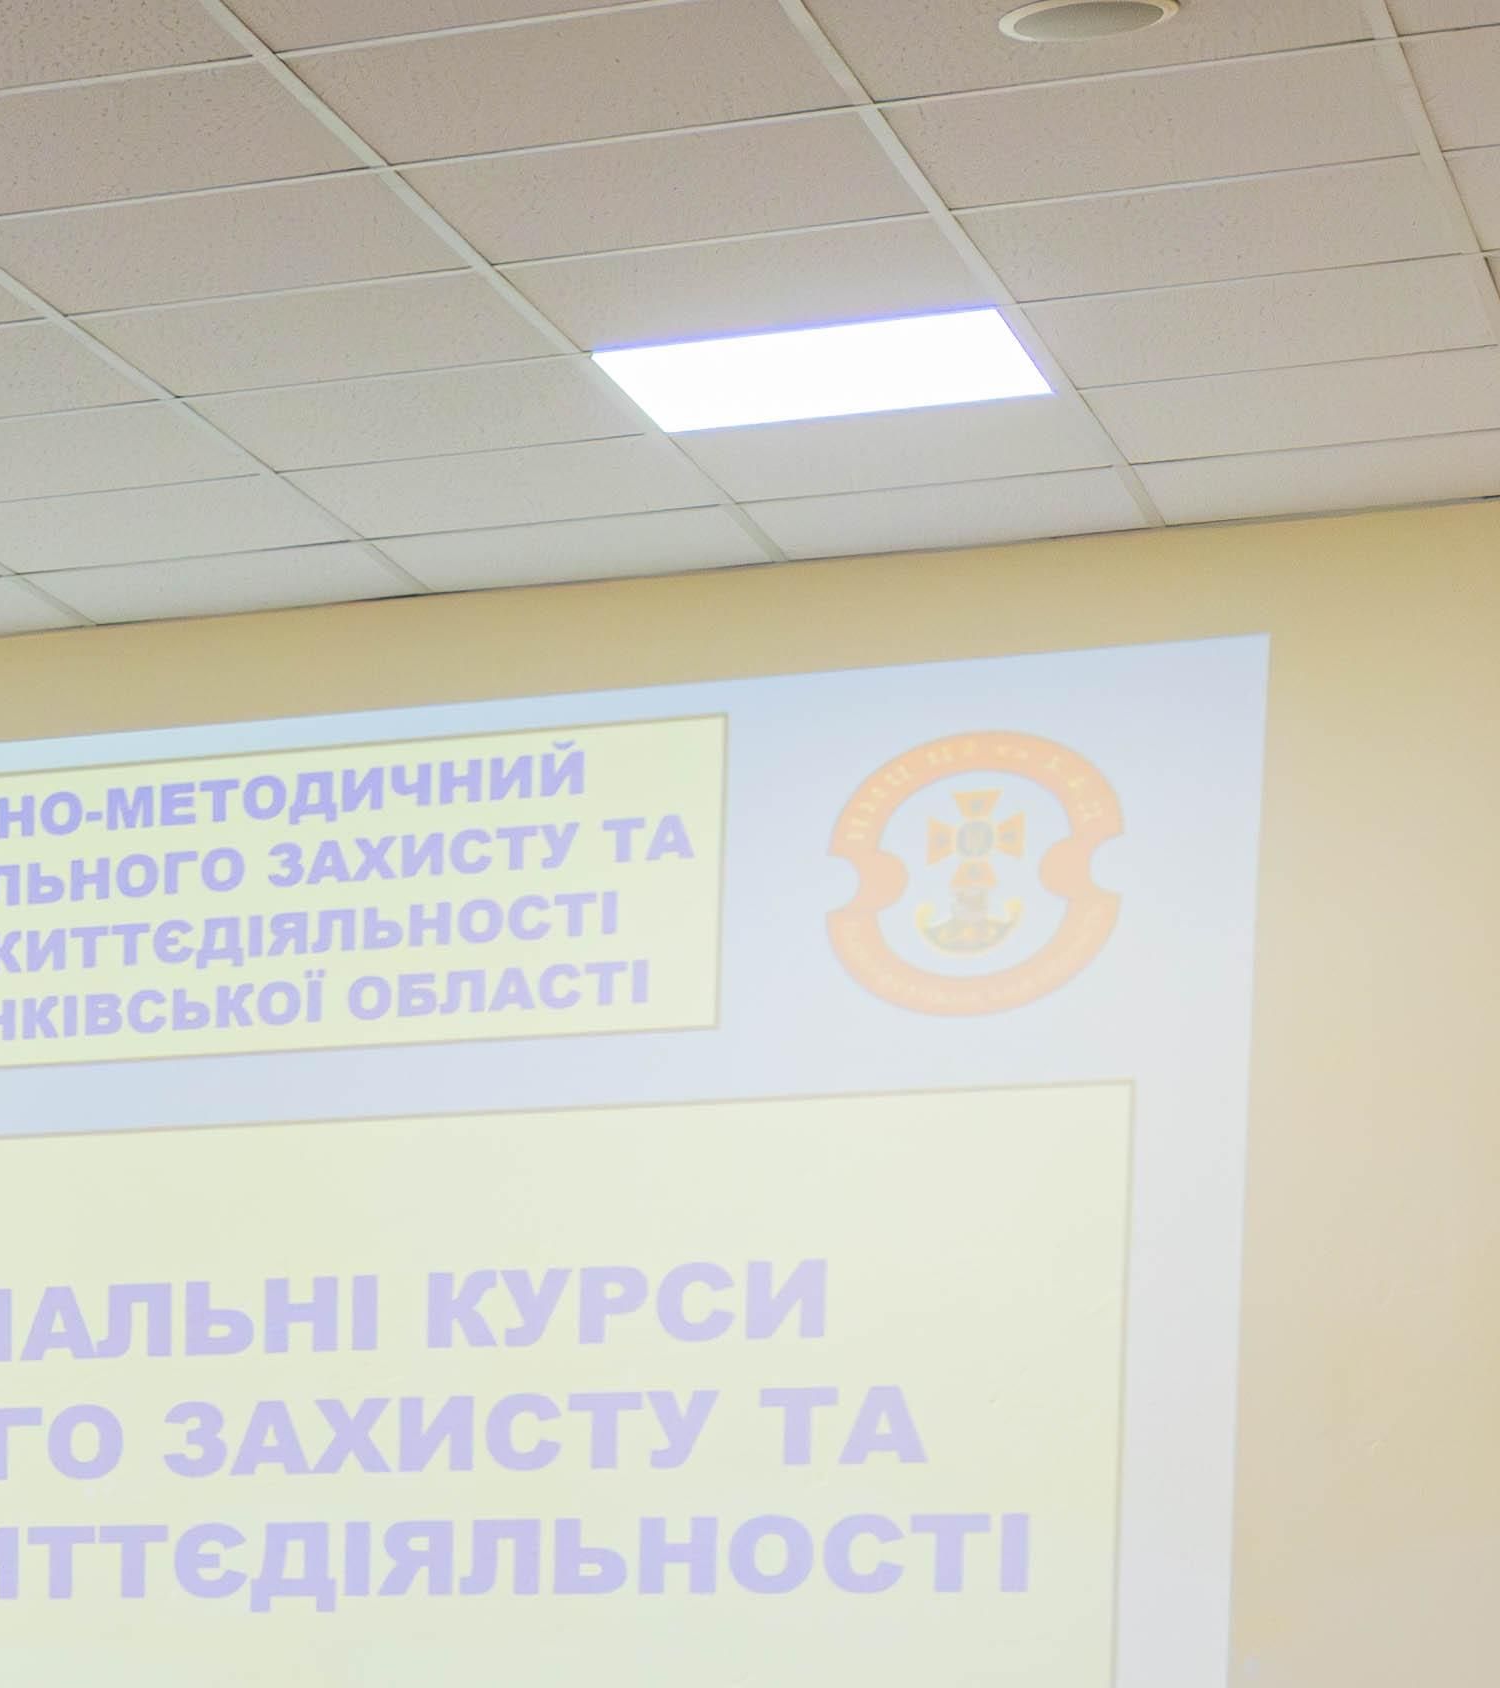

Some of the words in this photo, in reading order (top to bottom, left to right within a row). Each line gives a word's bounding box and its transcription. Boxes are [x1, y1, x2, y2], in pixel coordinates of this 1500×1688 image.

[266, 819, 581, 890] ЗАХИСТУ
[601, 812, 695, 865] ТА
[347, 958, 651, 1022] ОБЛАСТІ
[426, 1257, 829, 1350] КУРСИ
[161, 1388, 720, 1479] ЗАХИСТУ
[758, 1384, 929, 1468] ТА
